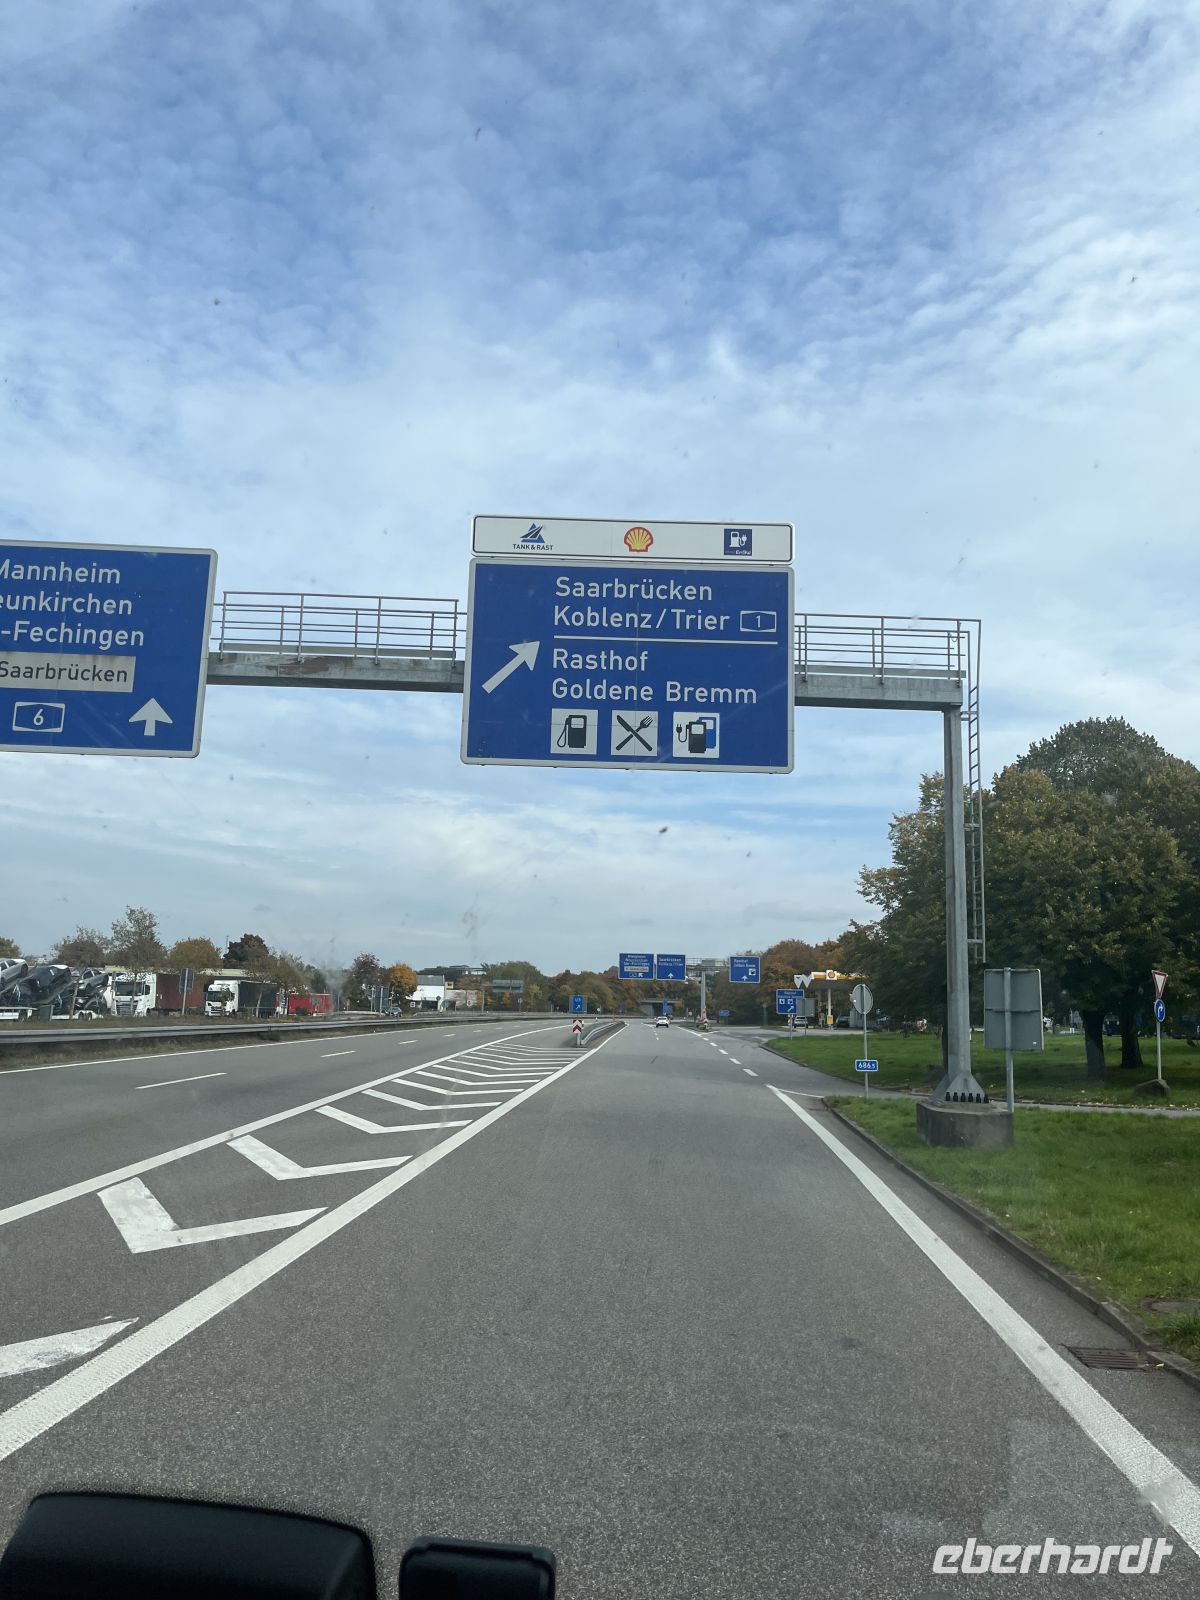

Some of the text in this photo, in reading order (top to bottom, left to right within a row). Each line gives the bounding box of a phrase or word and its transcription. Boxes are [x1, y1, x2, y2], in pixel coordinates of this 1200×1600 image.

[555, 577, 712, 601] Saarbrücken
[0, 591, 132, 615] unkirchen
[755, 616, 761, 628] 1
[552, 649, 648, 671] Rasthof
[0, 661, 128, 682] Saarbrücken
[552, 678, 757, 704] Goldene Bremm
[33, 709, 44, 726] 6
